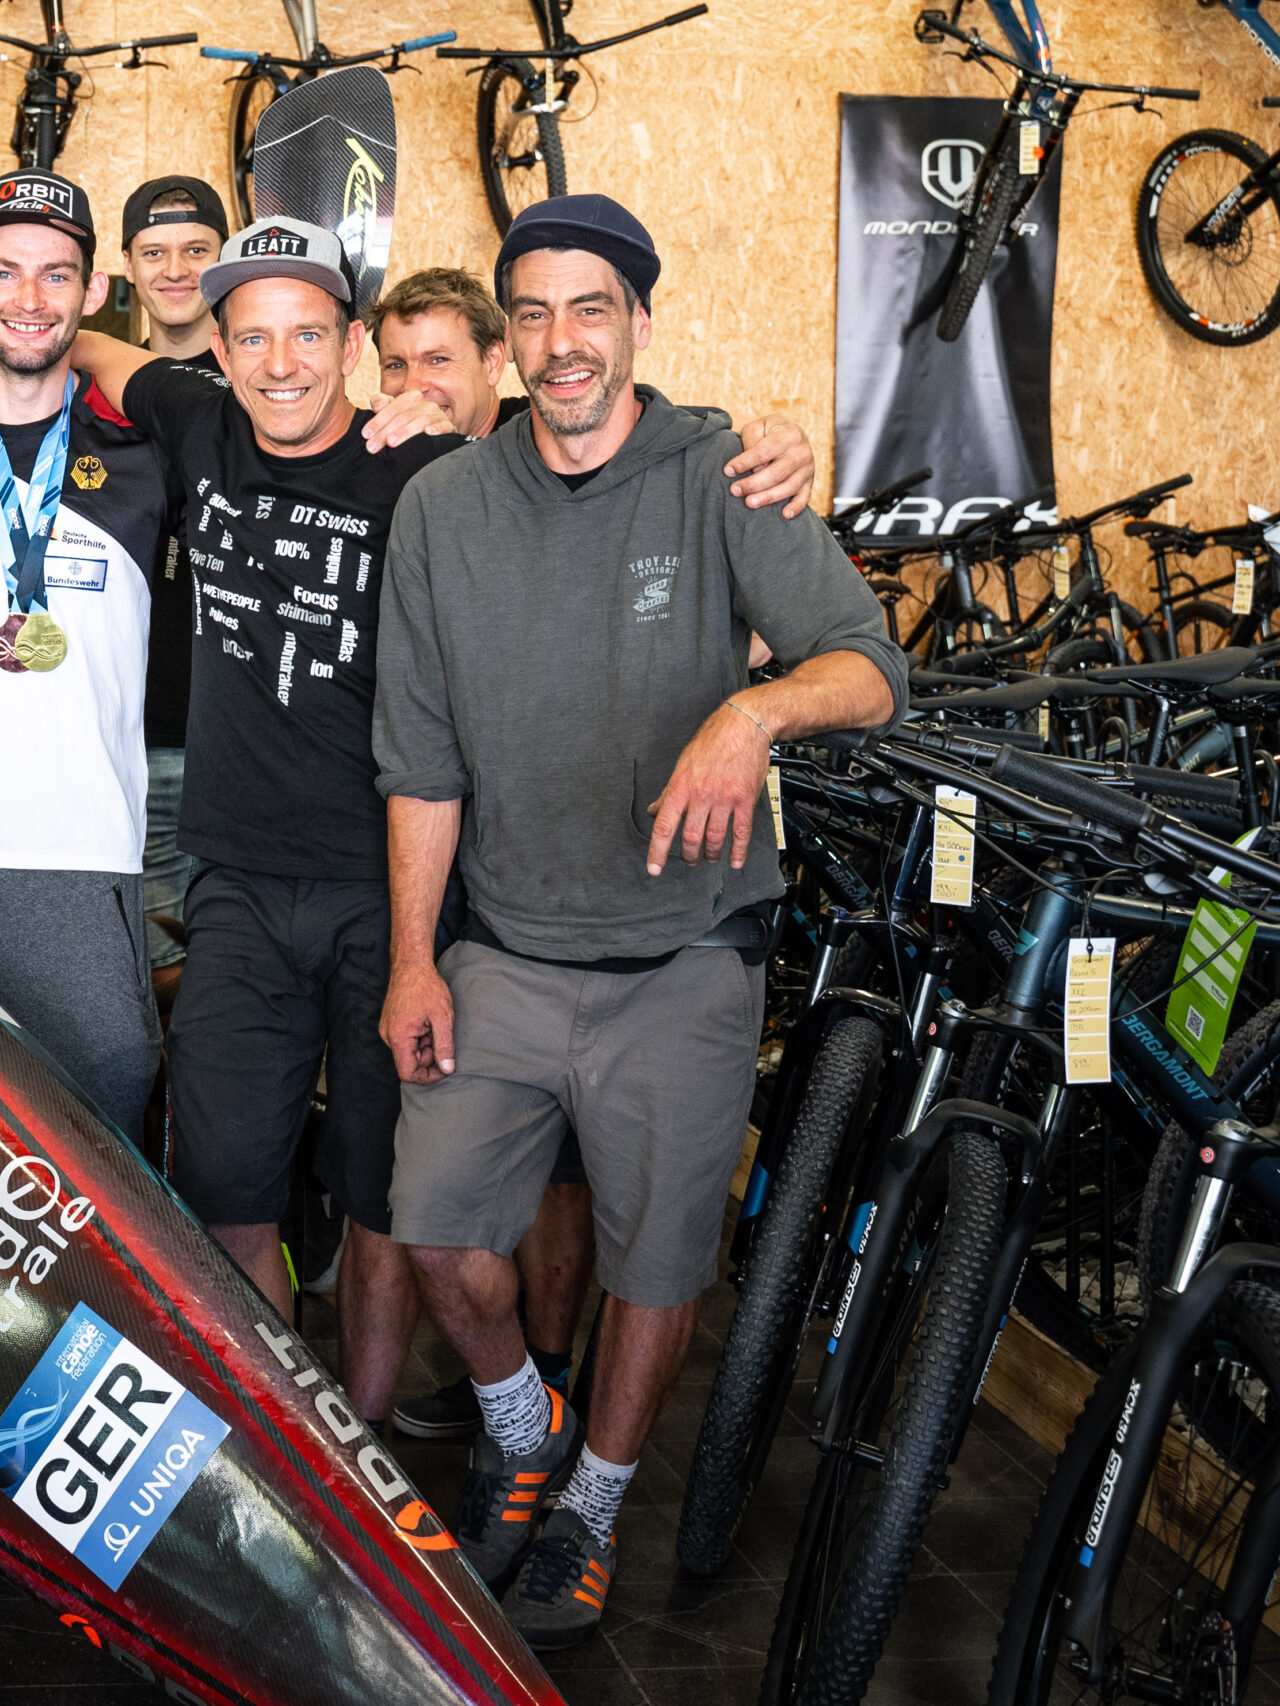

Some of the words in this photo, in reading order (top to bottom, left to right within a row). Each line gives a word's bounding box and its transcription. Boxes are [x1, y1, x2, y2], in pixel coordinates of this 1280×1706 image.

[0, 181, 69, 204] ORBIT
[248, 238, 300, 255] LEATT
[208, 493, 242, 518] aucer
[290, 505, 316, 525] DT
[315, 511, 369, 537] Swiss
[61, 535, 107, 551] Sporthilfe
[274, 539, 310, 560] 100%
[323, 538, 343, 585] kubikes
[356, 552, 371, 592] conway
[628, 556, 659, 573] TROY
[47, 576, 100, 588] Bundeswehr
[277, 603, 332, 627] shimano
[310, 659, 333, 679] ion
[55, 1318, 89, 1367] international
[61, 1324, 99, 1375] canoe
[70, 1332, 107, 1381] federation
[35, 1363, 172, 1525] GER
[130, 1429, 205, 1517] UNIQA
